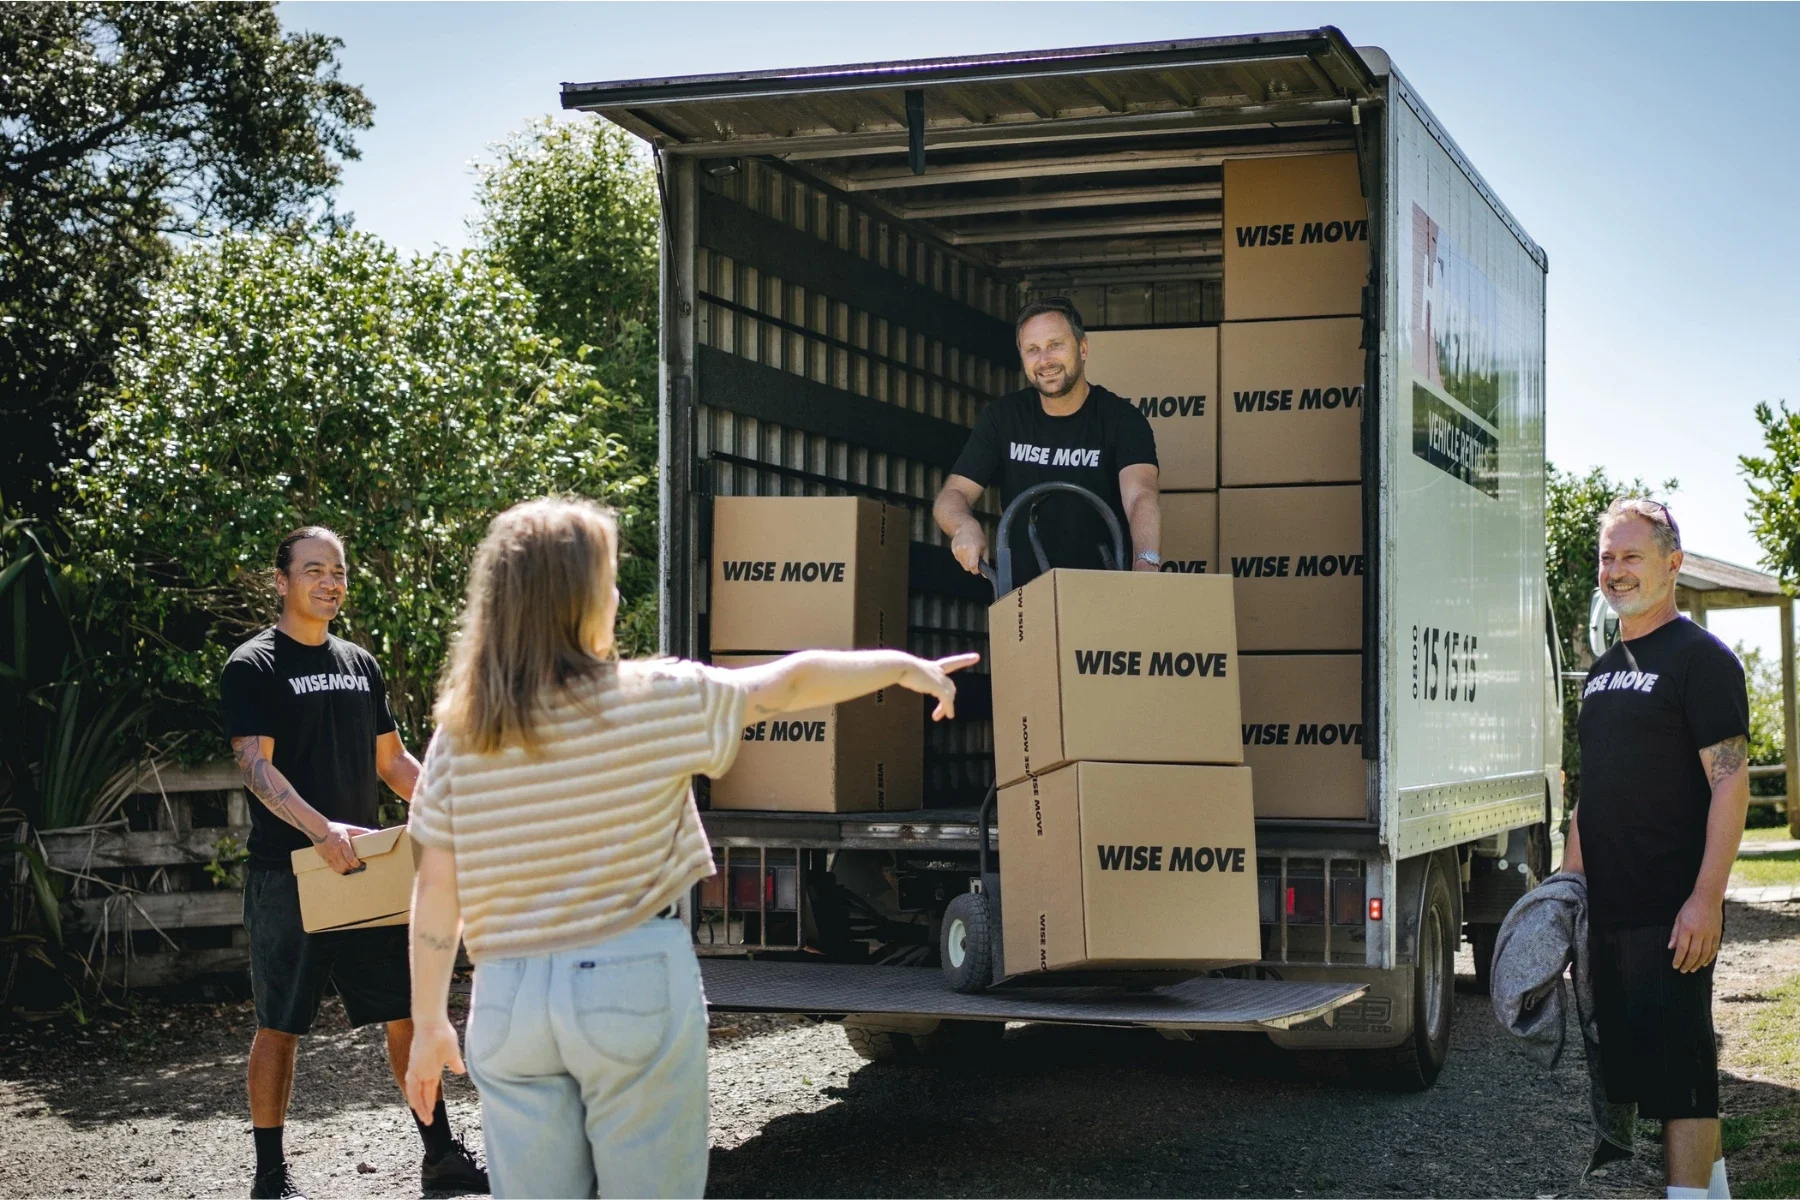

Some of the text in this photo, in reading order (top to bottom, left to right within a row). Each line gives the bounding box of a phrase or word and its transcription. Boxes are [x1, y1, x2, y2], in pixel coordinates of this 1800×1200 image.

[1236, 224, 1295, 247] WISE
[1139, 395, 1206, 418] MOVE
[1233, 390, 1293, 412] WISE
[1428, 409, 1460, 462] VEHICLE
[1010, 442, 1100, 467] WISE MOVE
[723, 561, 846, 582] WISE MOVE
[1159, 561, 1208, 574] OVE
[1231, 555, 1363, 578] WISE MOVE
[1075, 650, 1227, 677] WISE MOVE
[1423, 627, 1440, 701] 15
[1444, 631, 1459, 702] 15
[1463, 635, 1477, 703] 15
[288, 673, 329, 695] WISE
[1608, 671, 1659, 692] MOVE
[741, 721, 827, 742] SE MOVE
[1034, 799, 1043, 836] MOVE
[1097, 845, 1246, 872] WISE MOVE
